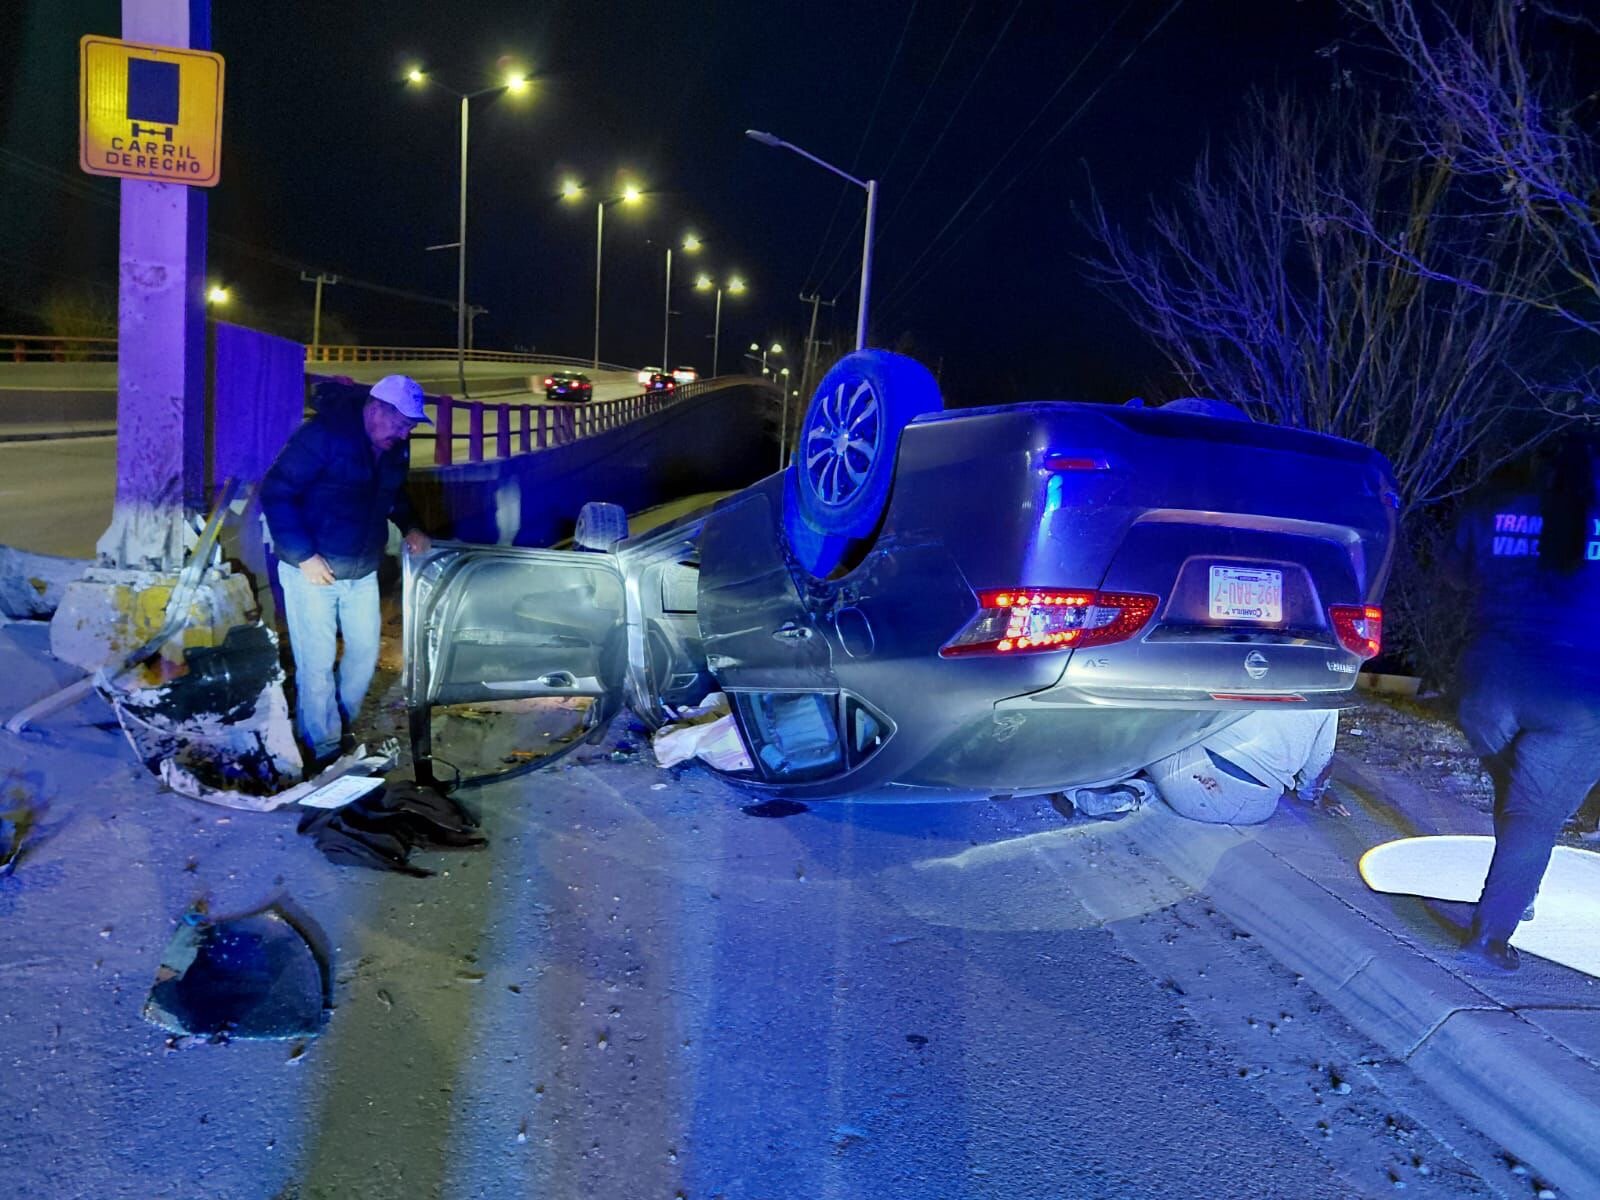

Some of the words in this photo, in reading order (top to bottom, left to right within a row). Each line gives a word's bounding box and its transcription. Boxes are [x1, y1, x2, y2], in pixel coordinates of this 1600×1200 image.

[111, 137, 197, 160] CARRIL
[106, 151, 201, 174] DERECHO
[1495, 514, 1543, 534] TRAN
